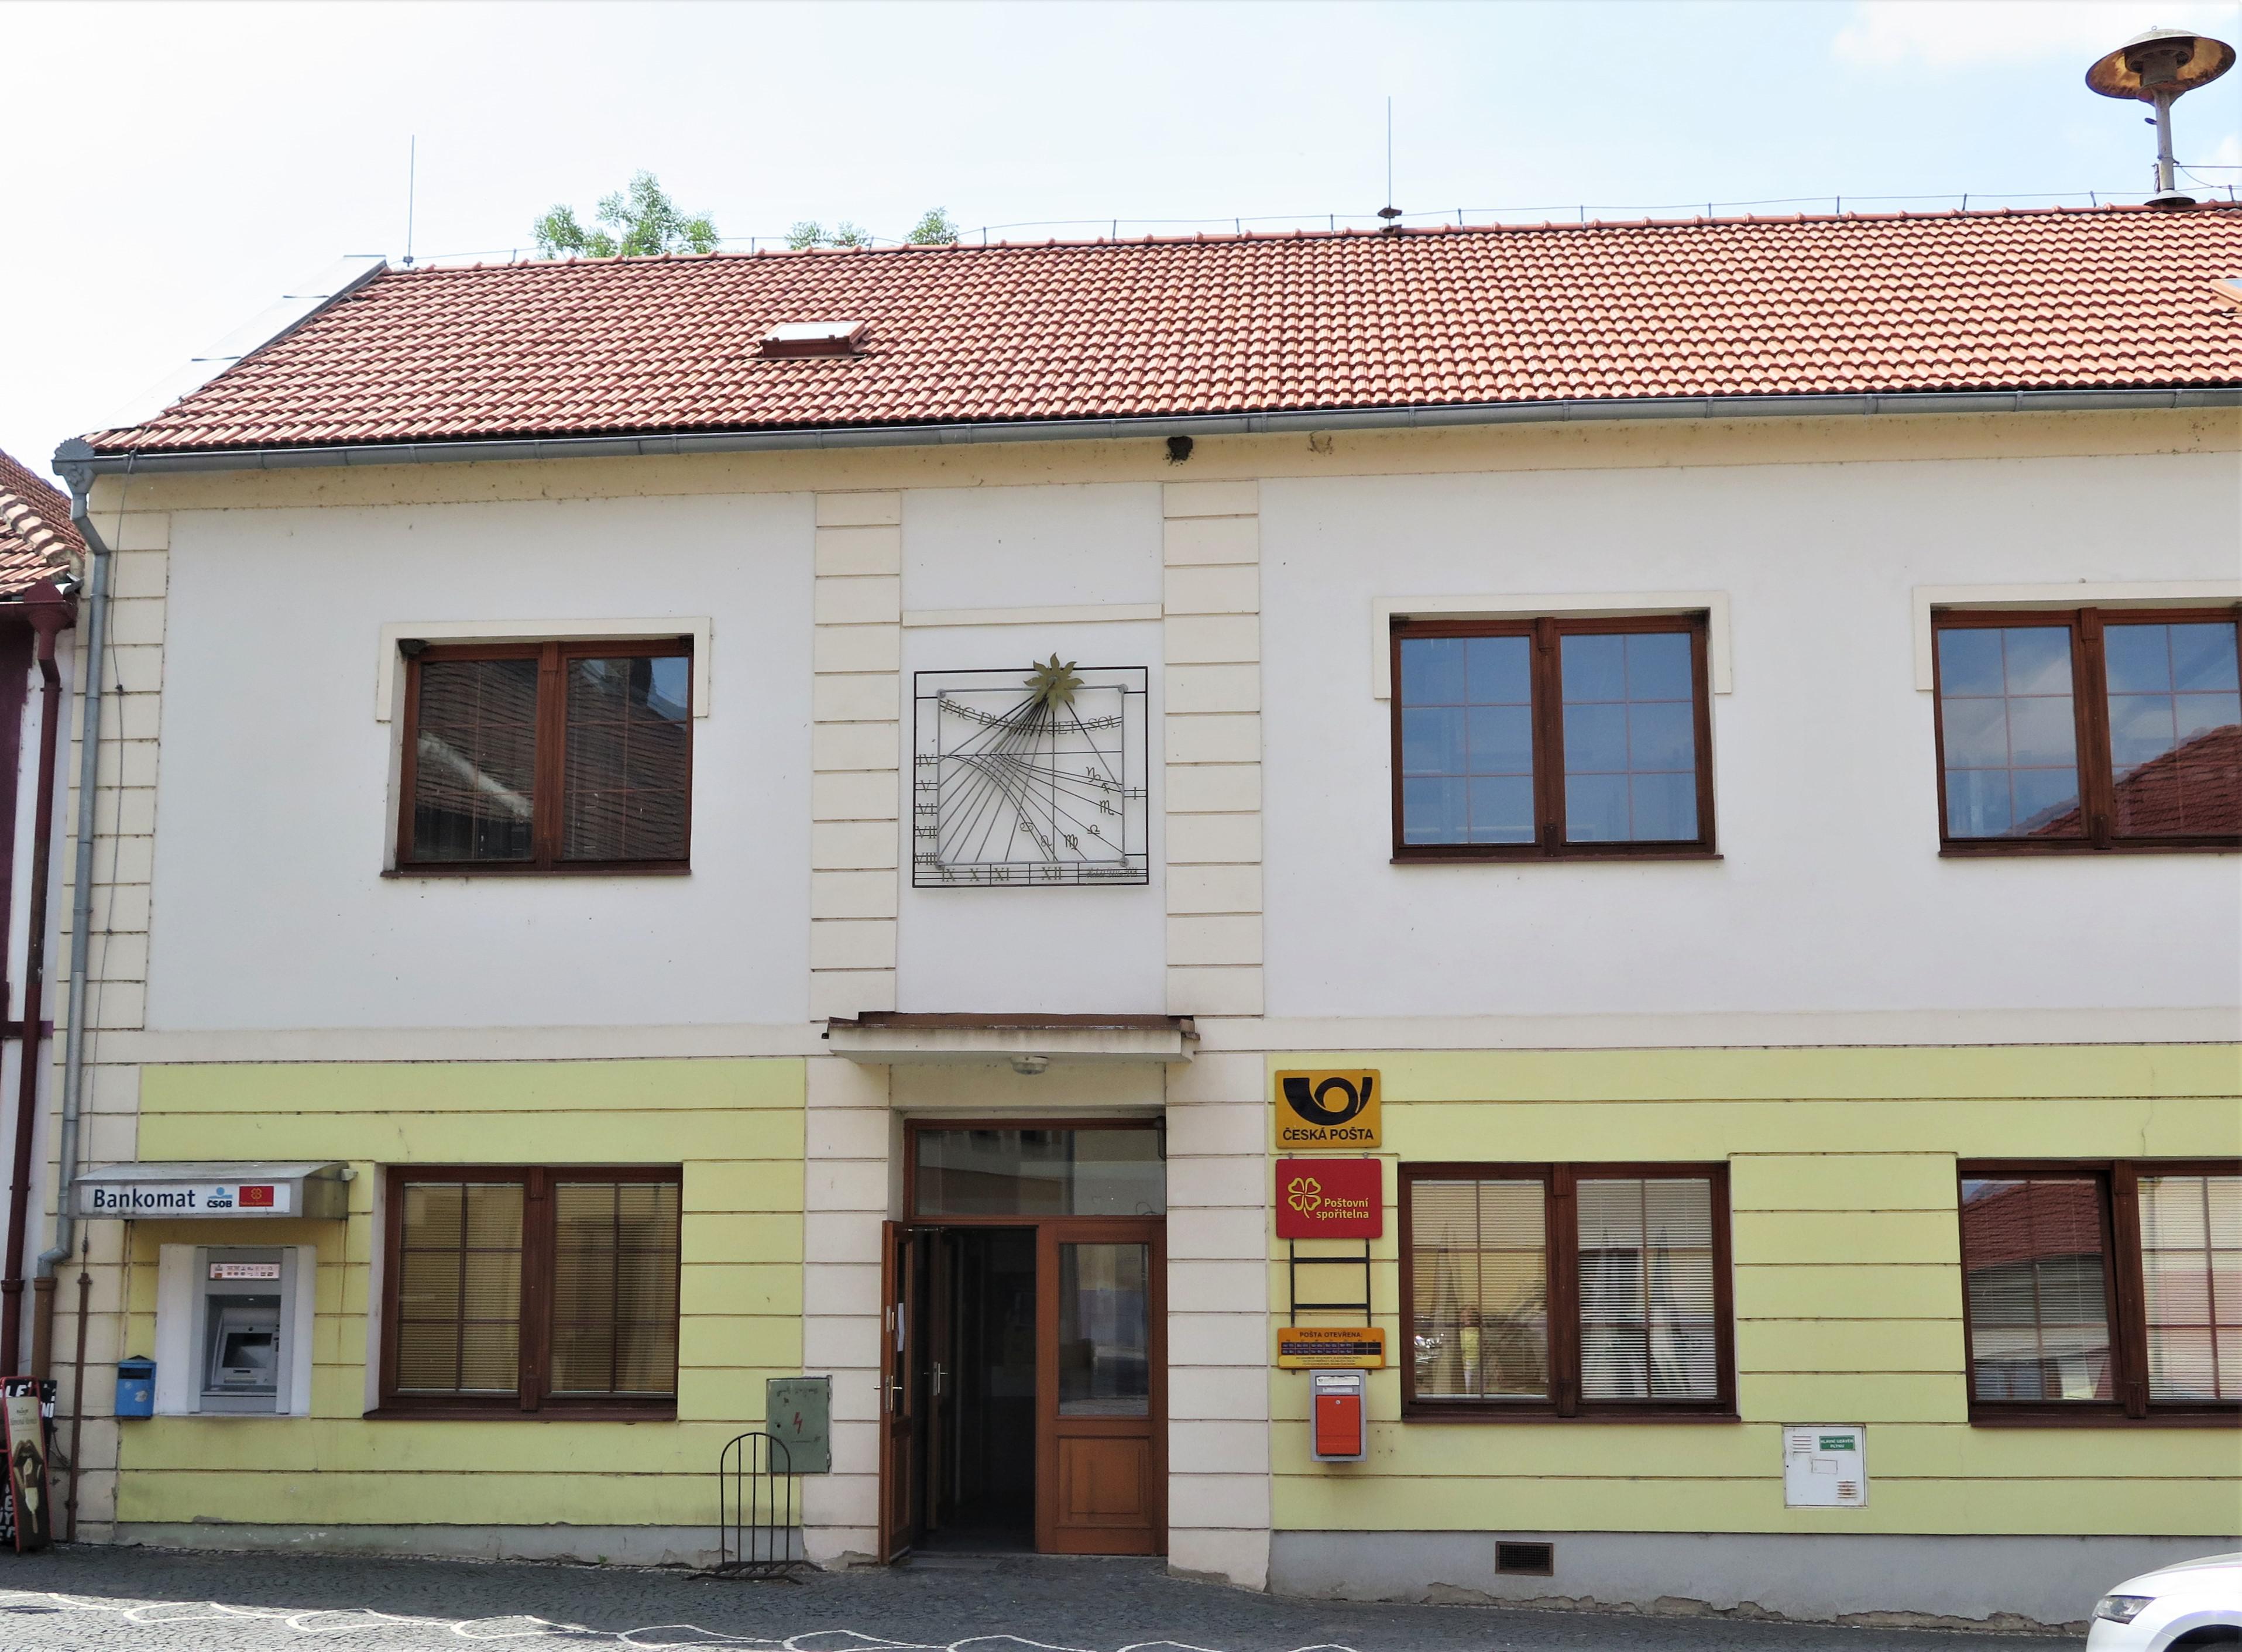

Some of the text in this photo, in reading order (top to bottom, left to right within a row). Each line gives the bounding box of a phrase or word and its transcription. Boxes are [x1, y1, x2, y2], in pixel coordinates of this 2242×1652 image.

[1088, 715, 1120, 731] SOL
[919, 754, 935, 767] IV
[921, 780, 932, 792] V
[918, 803, 933, 816] VI
[916, 826, 936, 839] VII
[914, 852, 937, 866] VIII
[942, 867, 1062, 882] IX X XI XII
[1283, 1126, 1374, 1141] ČESKÁ POŠTA
[94, 1189, 233, 1208] Bankomat ČSOB
[1324, 1198, 1368, 1208] Poštovní
[1316, 1208, 1369, 1221] spořitelna
